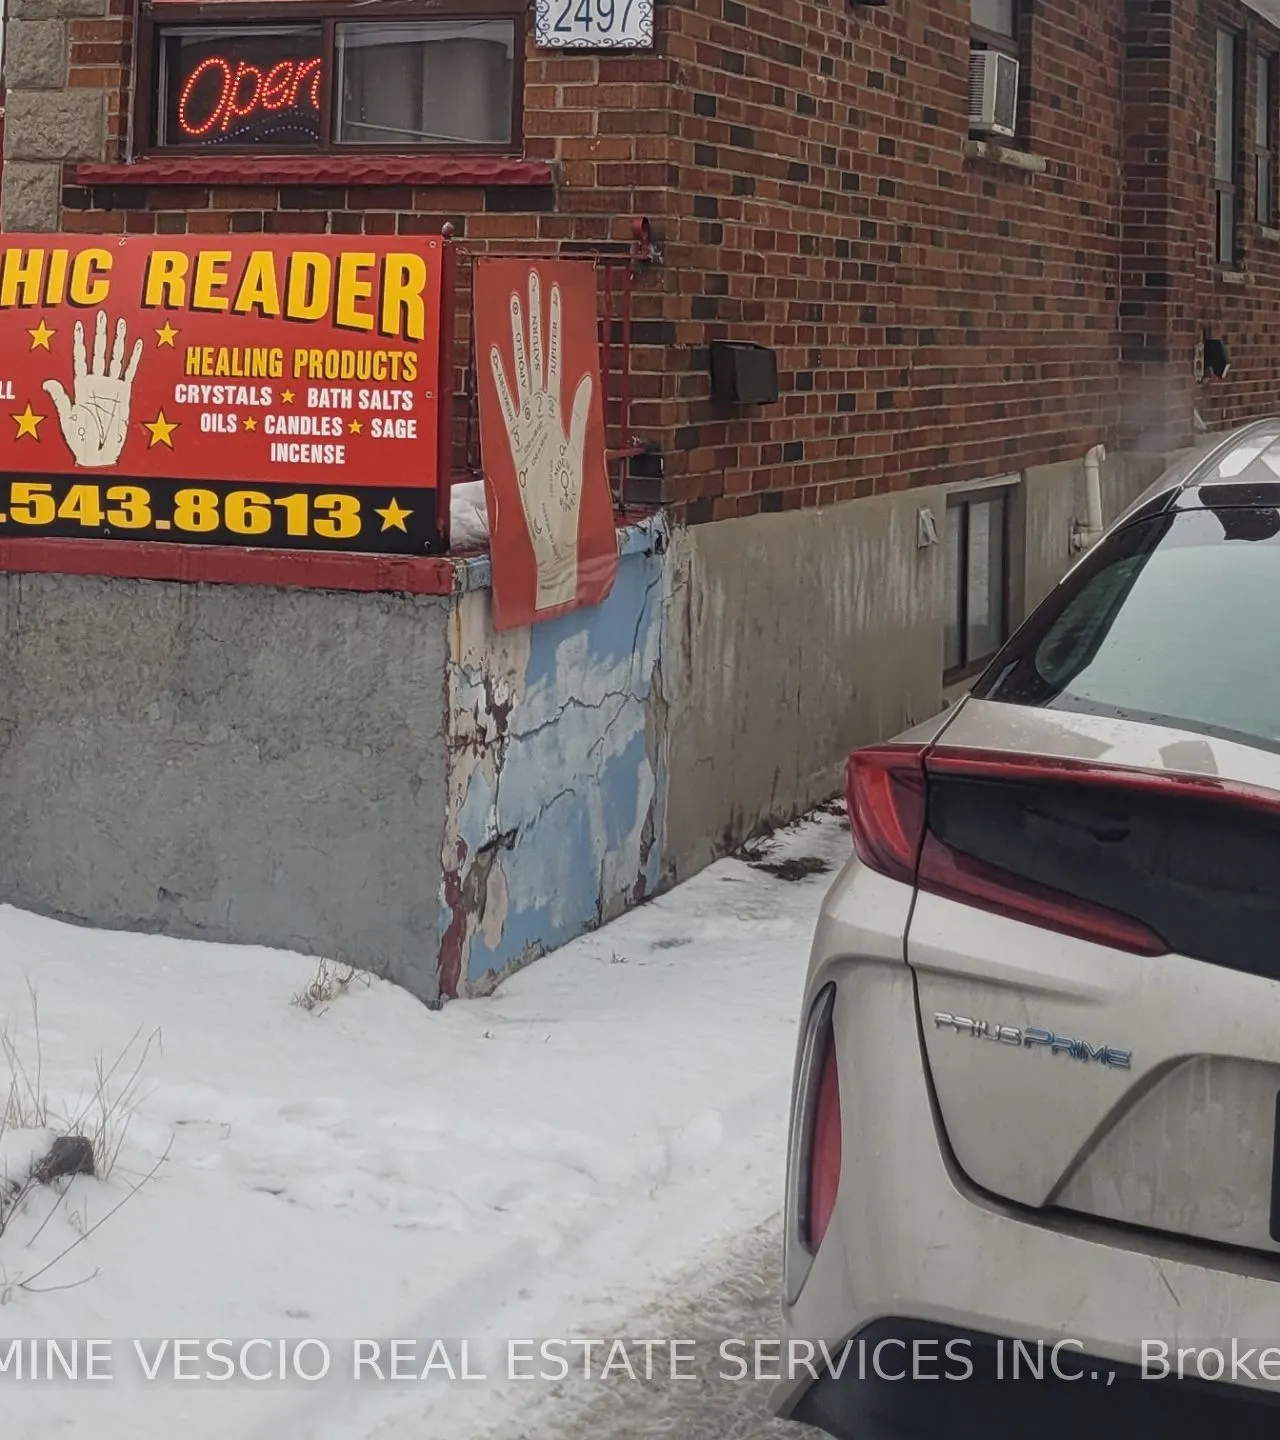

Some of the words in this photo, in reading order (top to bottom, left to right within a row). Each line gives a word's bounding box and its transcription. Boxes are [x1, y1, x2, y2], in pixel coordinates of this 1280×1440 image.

[179, 58, 321, 134] Open
[144, 250, 427, 341] READER
[185, 346, 283, 378] HEALING
[293, 348, 418, 382] PRODUCTS
[515, 332, 528, 389] APOLLO
[174, 384, 273, 407] CRYSTALS
[307, 387, 353, 409] BATH
[358, 389, 414, 411] SALTS
[200, 413, 237, 433] OILS
[264, 415, 343, 437] CANDLES
[370, 418, 417, 439] SAGE
[270, 443, 346, 464] INCENSE
